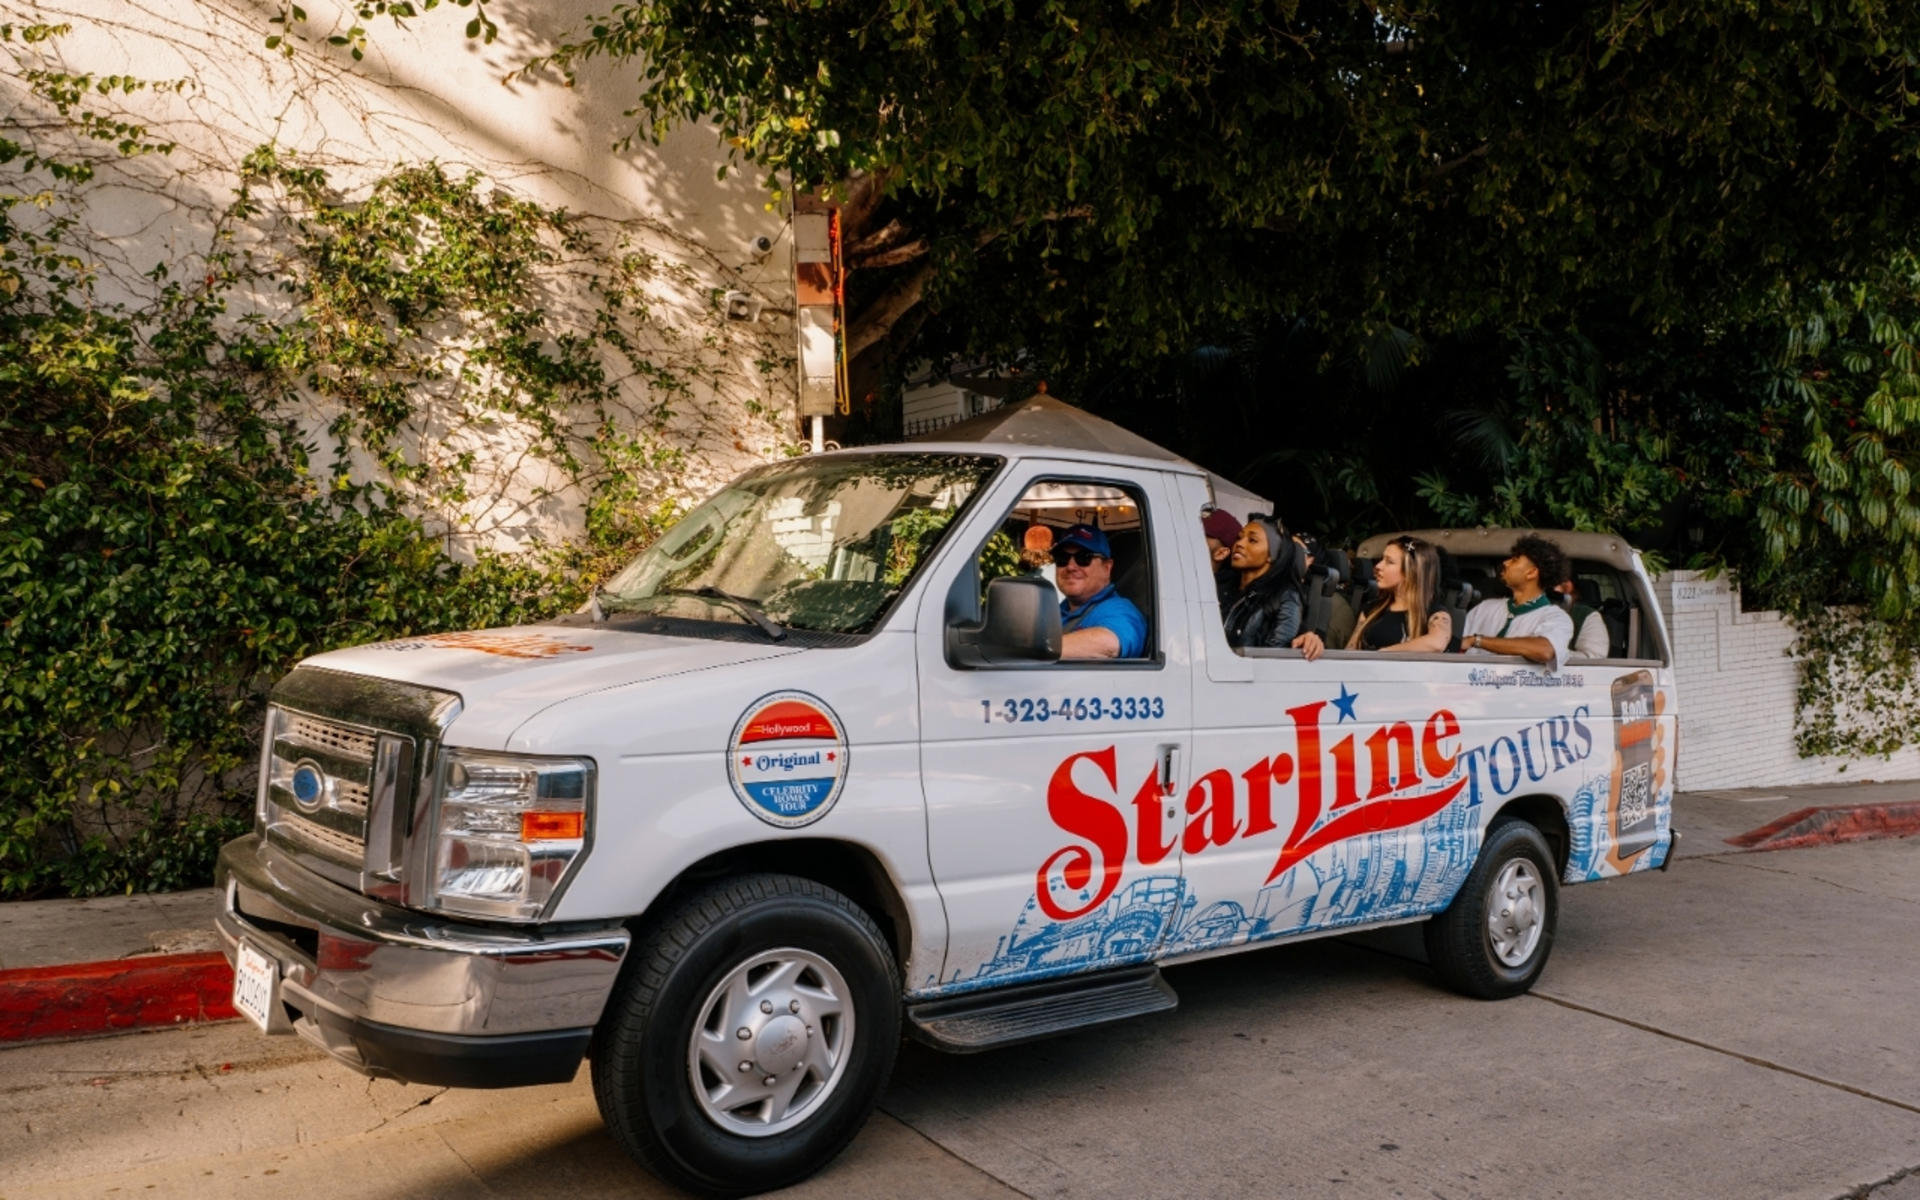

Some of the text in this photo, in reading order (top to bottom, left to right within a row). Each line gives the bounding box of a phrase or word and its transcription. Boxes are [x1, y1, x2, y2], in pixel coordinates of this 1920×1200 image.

[981, 696, 1164, 723] 1-323-463-3333
[761, 723, 810, 736] Hollywood
[756, 751, 820, 771] Original
[1458, 705, 1593, 809] TOURS
[762, 784, 818, 797] CELEBRITY
[780, 801, 807, 812] TOUR
